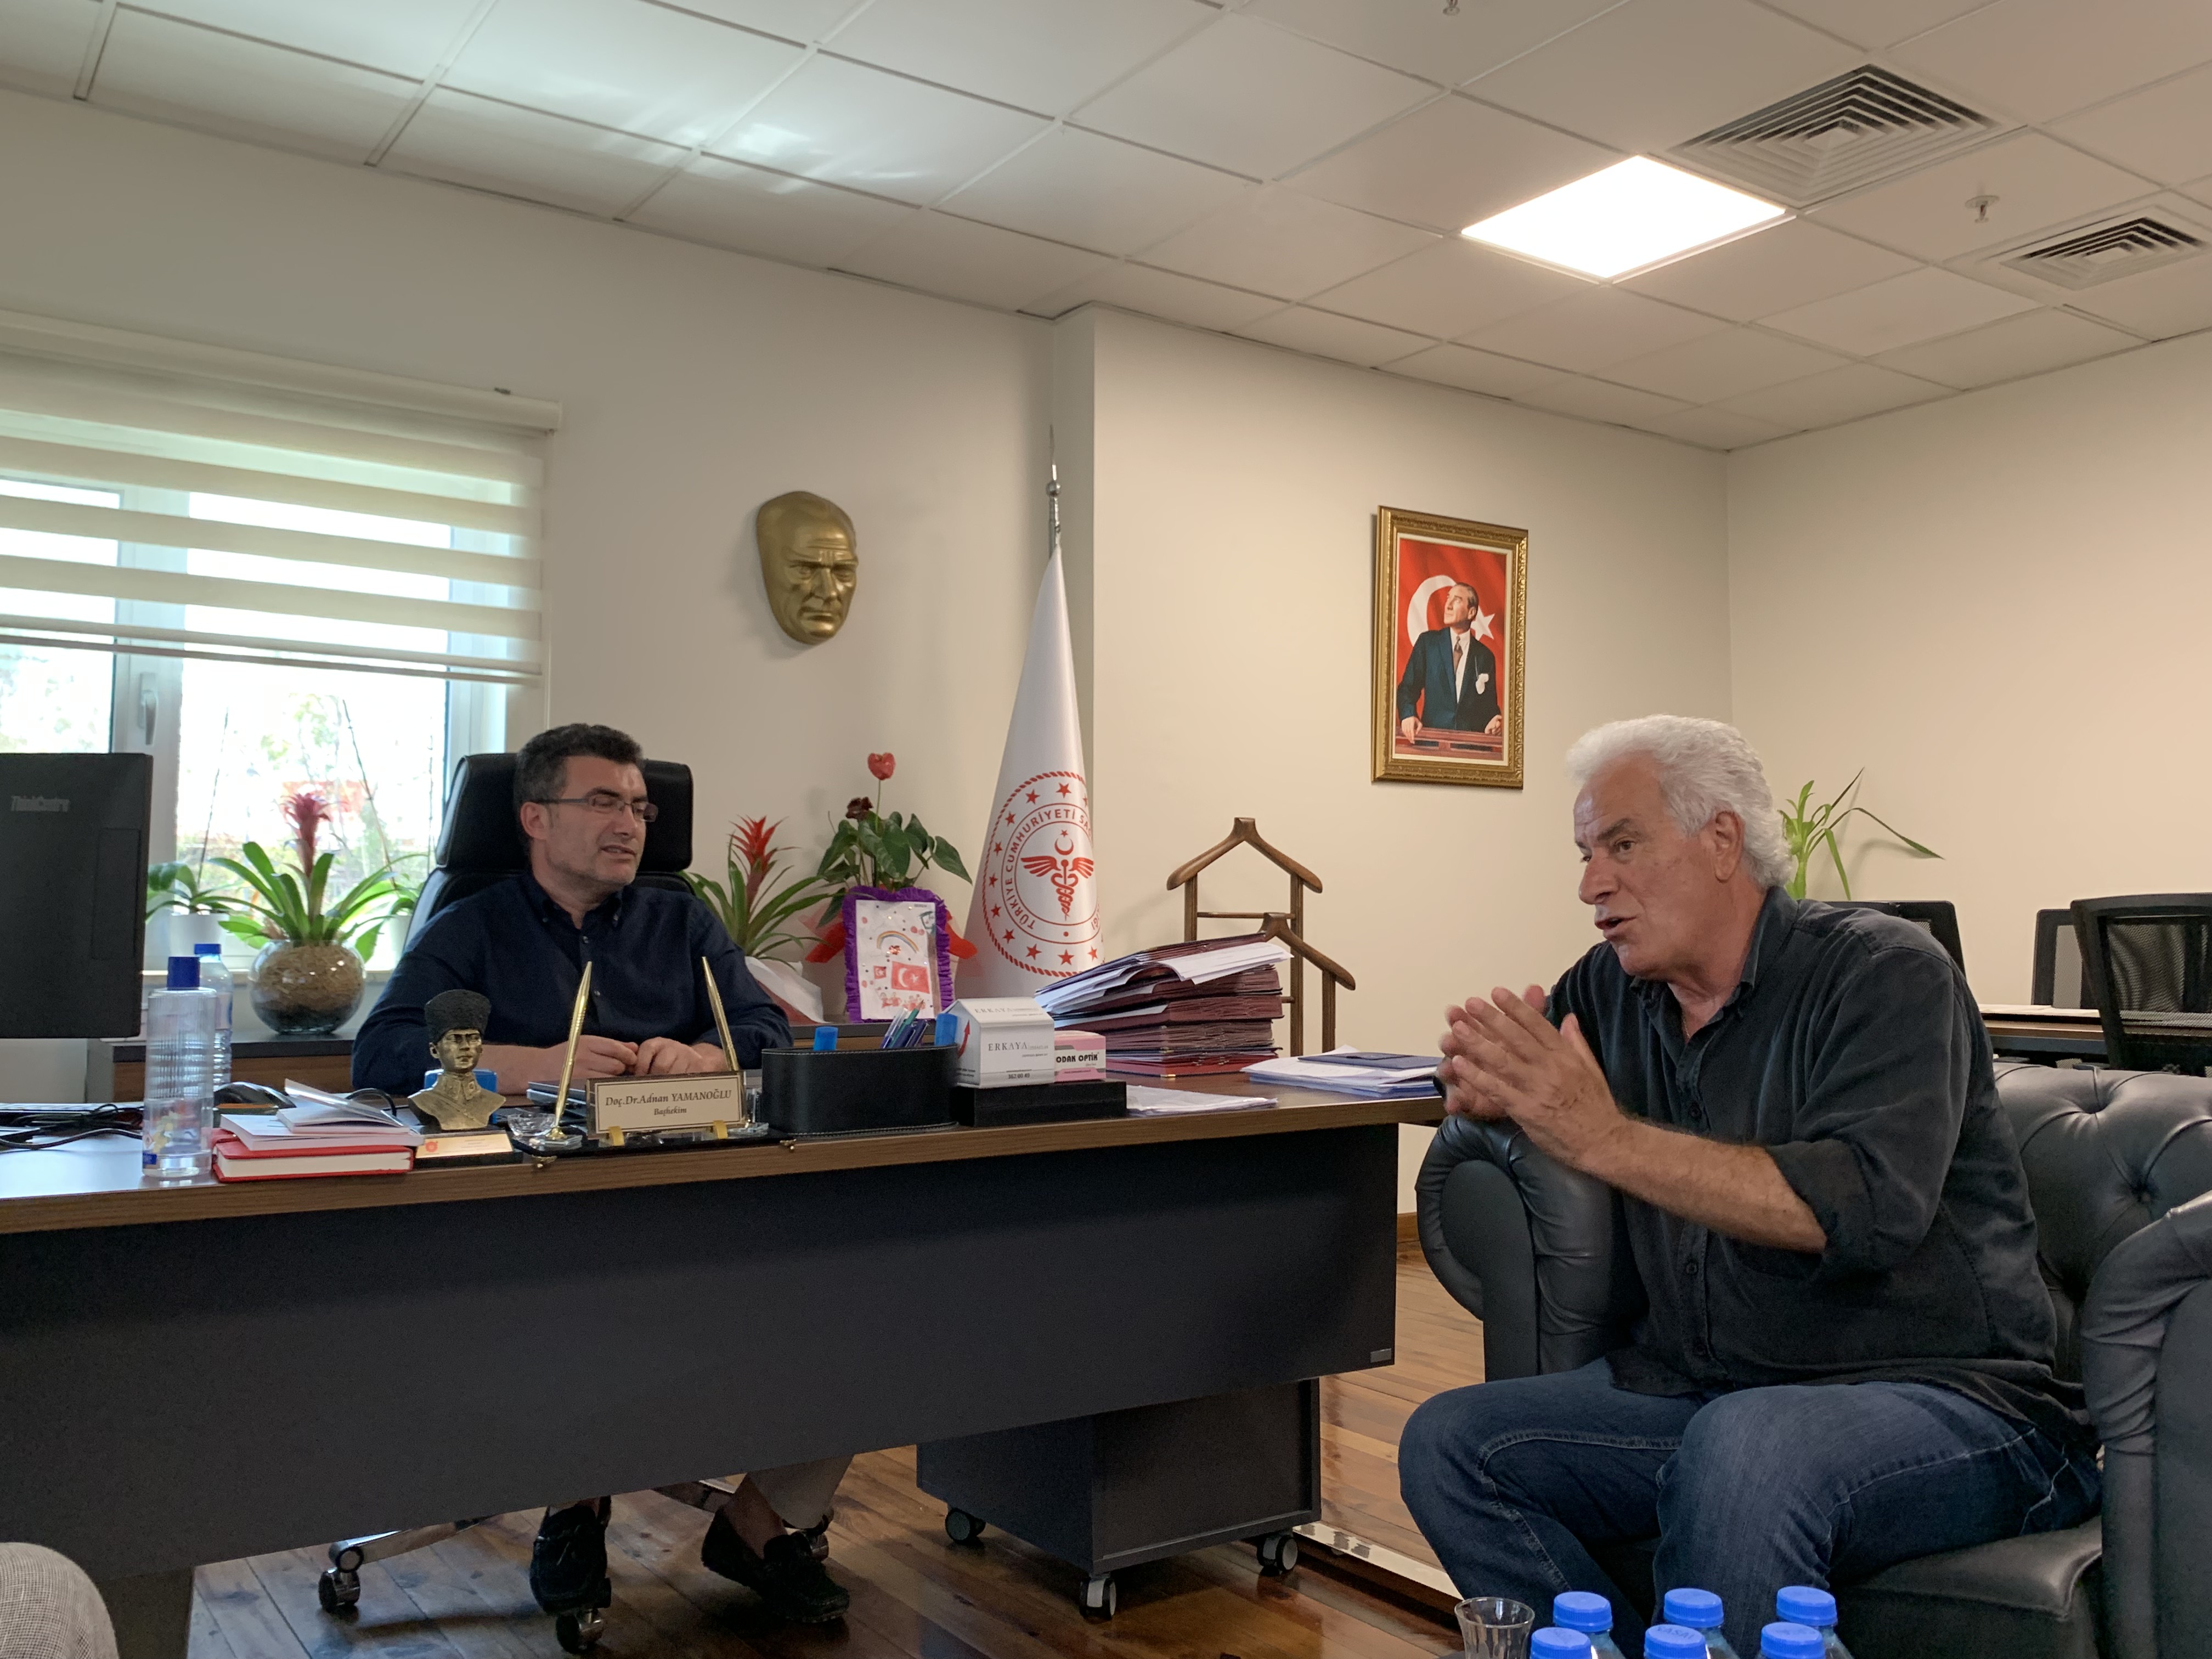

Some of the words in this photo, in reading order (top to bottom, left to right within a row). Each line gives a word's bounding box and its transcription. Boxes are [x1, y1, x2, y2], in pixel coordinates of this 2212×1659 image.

[988, 1041, 1028, 1051] ERKAYA
[1056, 1055, 1076, 1063] ODAK
[1078, 1052, 1098, 1062] OPTİK
[671, 1088, 732, 1102] YAMANOĞLU
[653, 1105, 687, 1116] Başhekim
